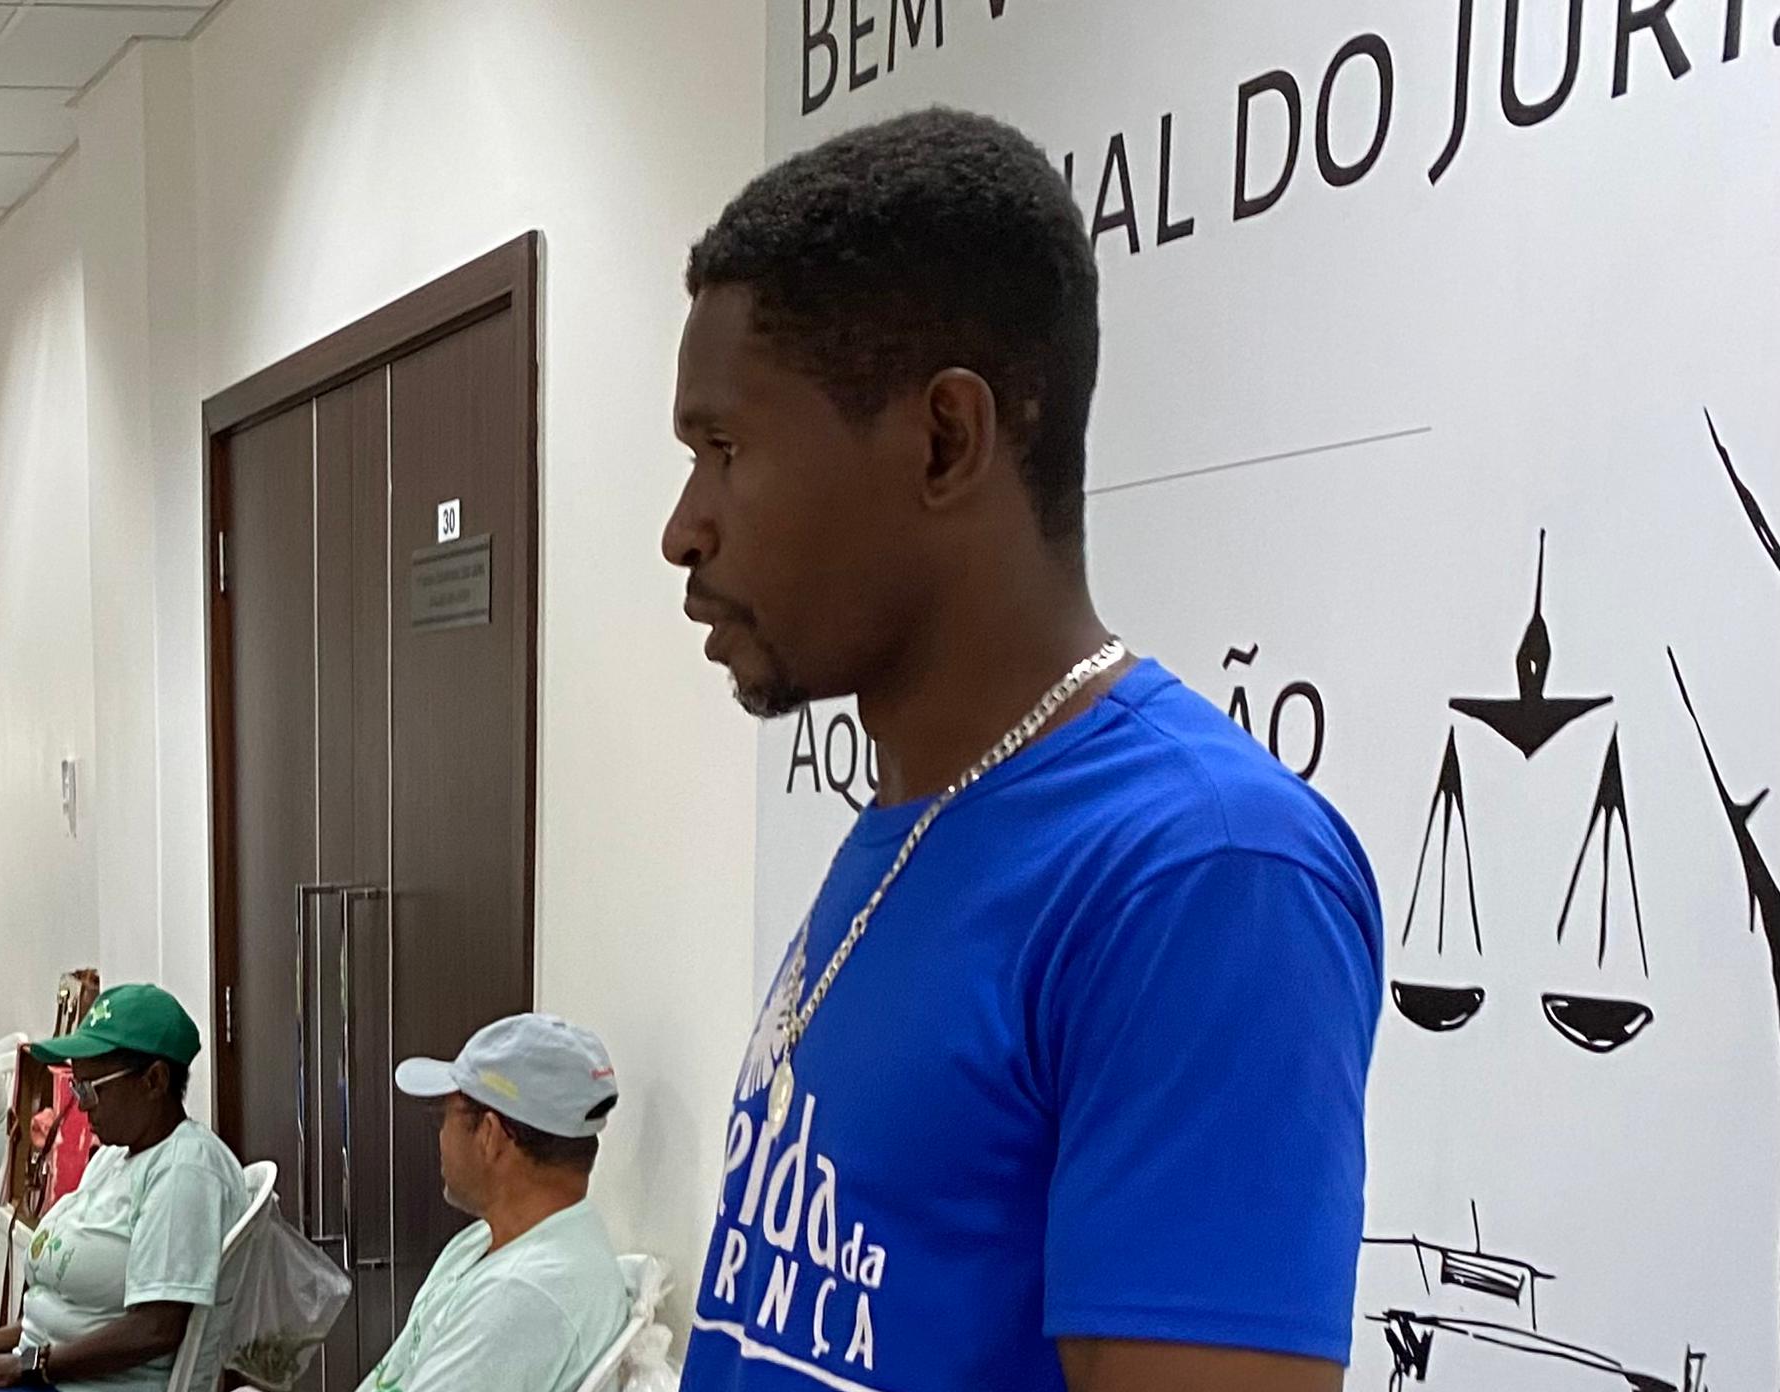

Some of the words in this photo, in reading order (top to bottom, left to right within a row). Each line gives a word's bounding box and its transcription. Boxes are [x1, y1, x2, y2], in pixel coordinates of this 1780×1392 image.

[1233, 33, 1394, 222] DO
[442, 507, 456, 535] 30
[840, 1221, 887, 1289] da
